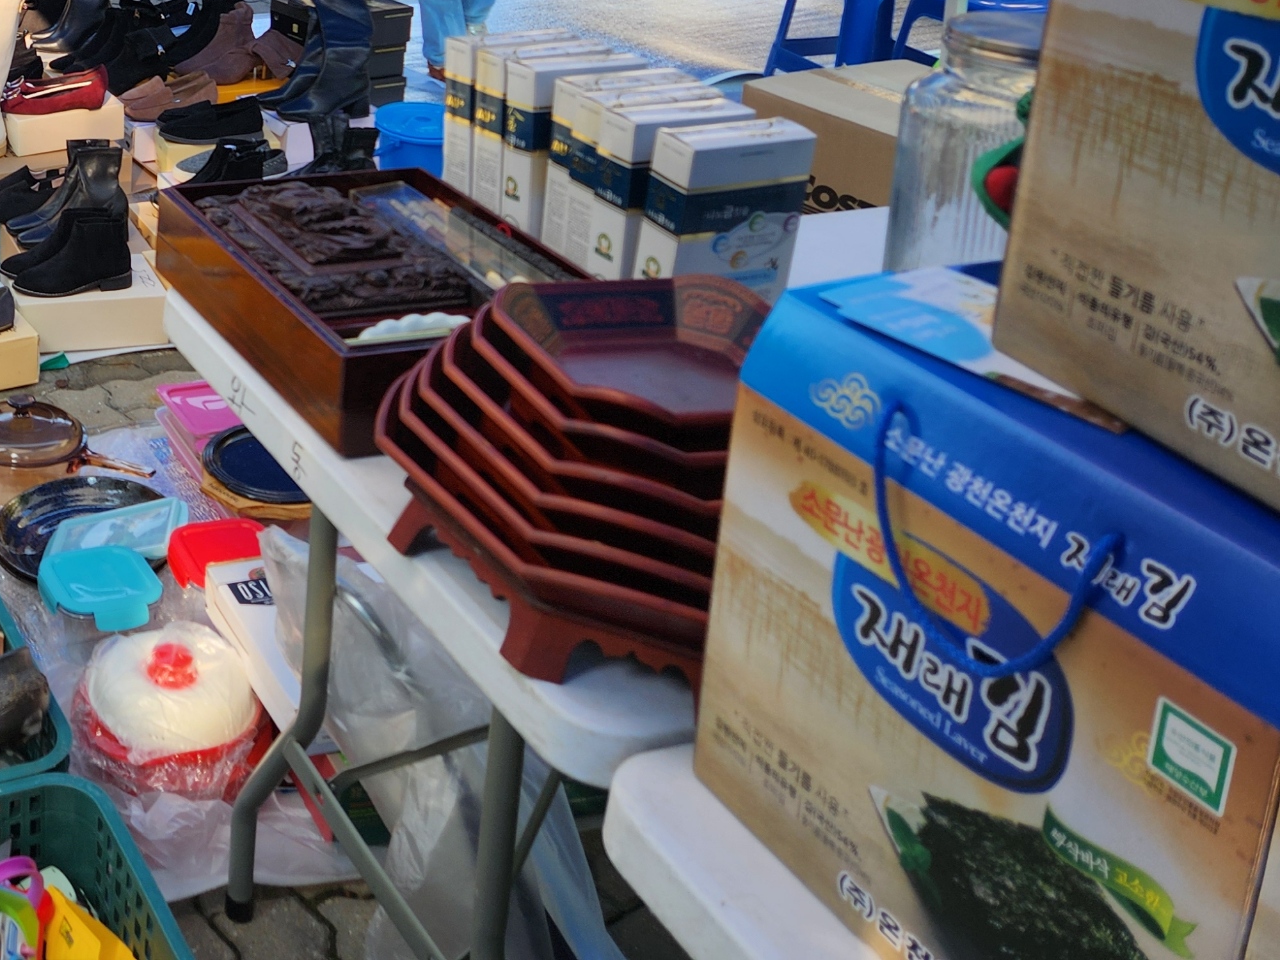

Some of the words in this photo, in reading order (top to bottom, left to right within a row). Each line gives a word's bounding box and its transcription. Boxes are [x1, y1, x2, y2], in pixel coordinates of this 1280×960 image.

[1107, 274, 1158, 313] 들기름
[1161, 297, 1195, 334] 사용
[1188, 397, 1278, 468] (주)온
[884, 422, 942, 479] 소문난
[944, 452, 1058, 549] 광천온천지
[237, 580, 273, 601] OSL
[801, 487, 989, 634] 소문난광온천지
[852, 582, 1052, 774] 재래김
